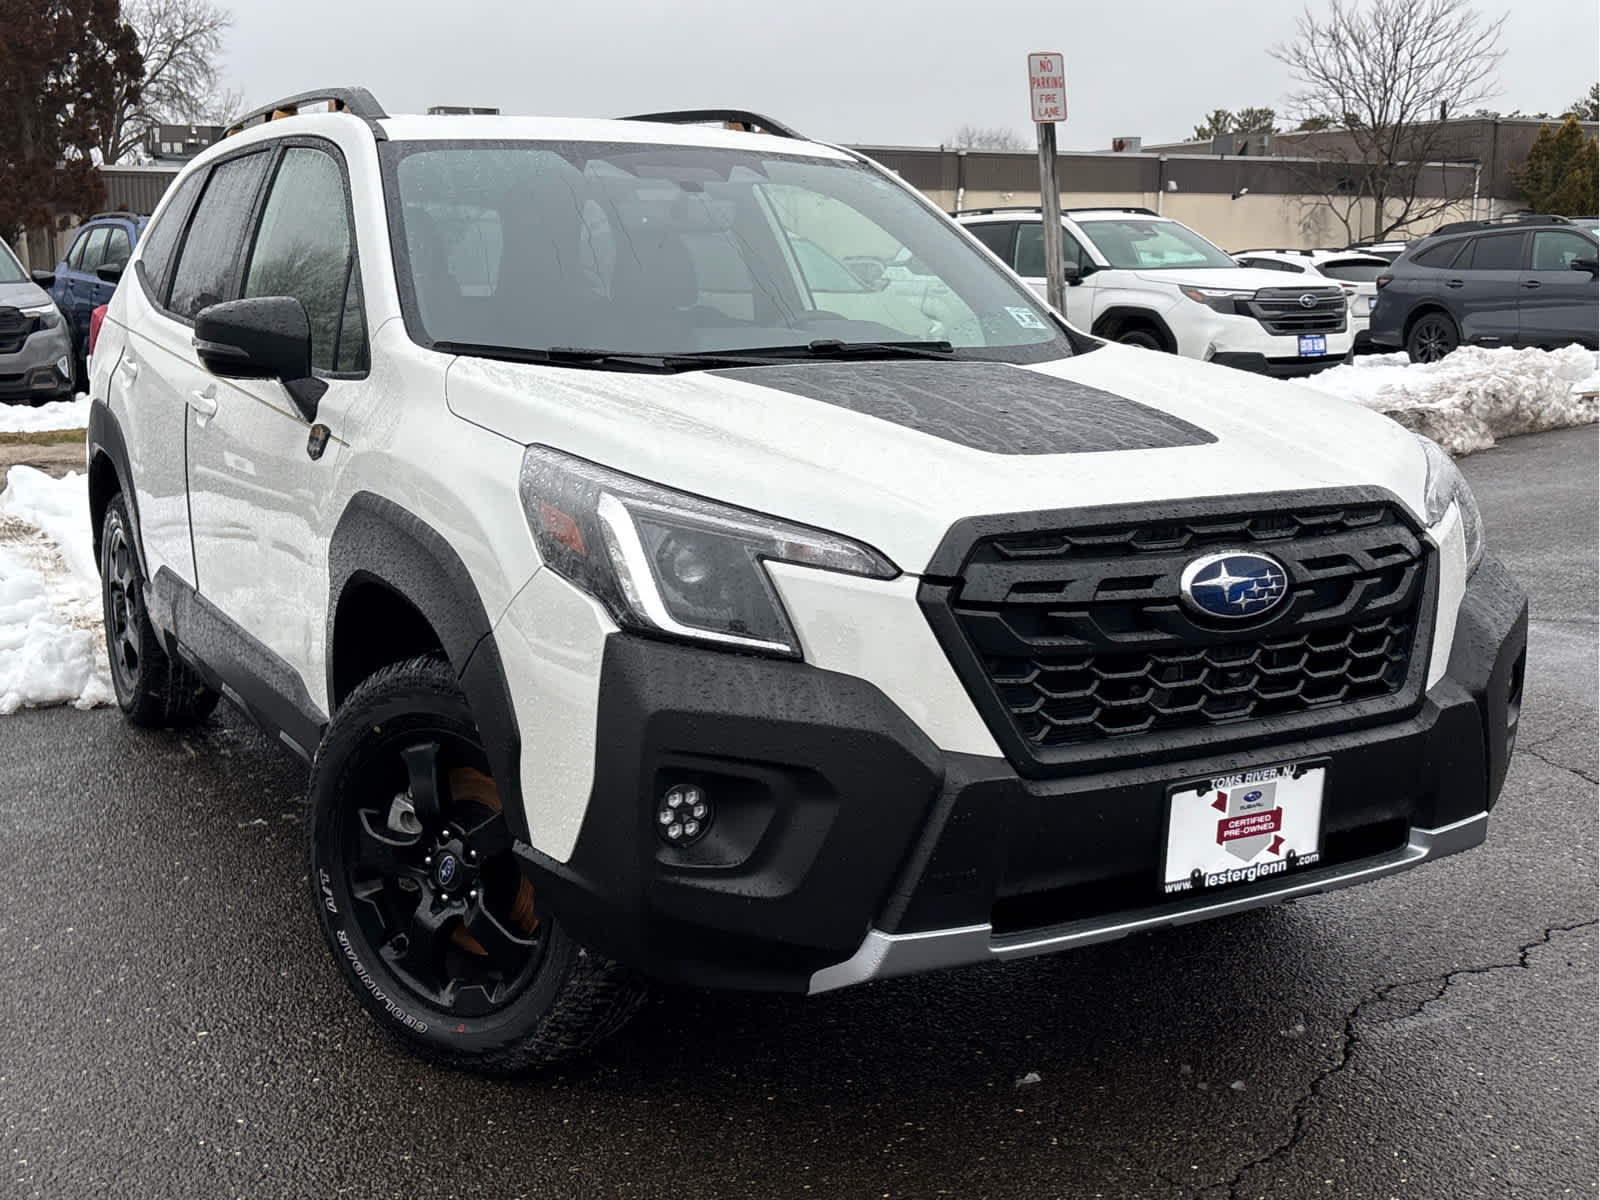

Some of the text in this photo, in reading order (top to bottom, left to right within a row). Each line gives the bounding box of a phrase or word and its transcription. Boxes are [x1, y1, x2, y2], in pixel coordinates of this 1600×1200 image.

[1039, 60, 1053, 72] NO
[1031, 77, 1063, 88] PARKING
[1040, 94, 1056, 103] FIRE
[1038, 107, 1060, 116] LANE
[1210, 774, 1243, 789] TOMS
[1282, 763, 1297, 777] NJ
[1228, 814, 1272, 829] CERTIFIED
[1223, 822, 1275, 838] PRE-OWNED
[1204, 860, 1288, 888] lesterglenn
